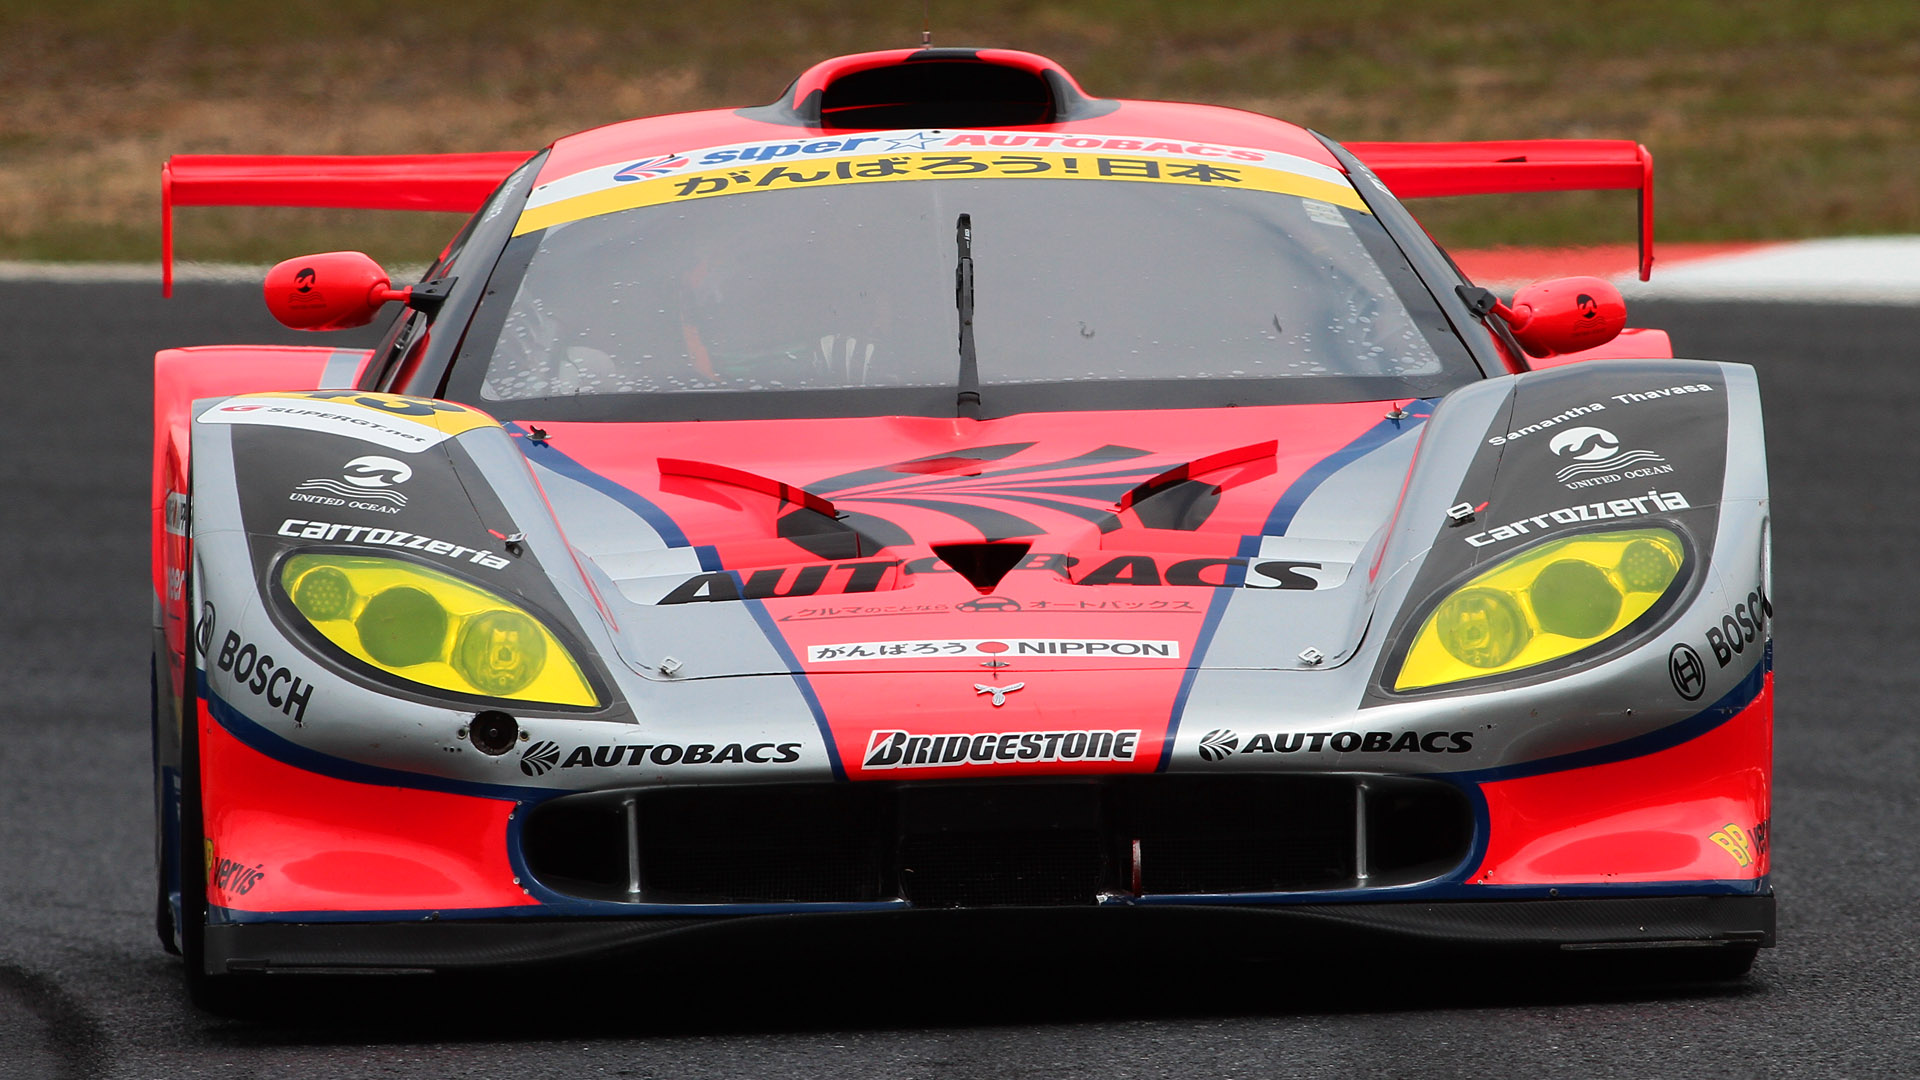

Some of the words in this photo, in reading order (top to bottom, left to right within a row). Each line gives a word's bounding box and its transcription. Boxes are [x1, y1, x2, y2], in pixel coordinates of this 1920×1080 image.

[698, 136, 881, 166] super
[943, 134, 1267, 162] AUTOBACS
[266, 407, 427, 443] SUPERGT.net
[1487, 400, 1606, 447] Samantha
[1611, 382, 1714, 405] Thavasa
[1565, 473, 1622, 491] UNITED
[1624, 464, 1674, 480] OCEAN
[288, 492, 345, 507] UNITED
[348, 500, 403, 515] OCEAN
[1463, 489, 1691, 549] carrozzeria
[277, 518, 511, 571] carrozzeria
[1029, 600, 1195, 610] オートバックス
[815, 641, 968, 660] がんばろう
[1018, 641, 1170, 657] NIPPON
[217, 629, 314, 723] BOSCH
[560, 743, 802, 769] AUTOBACS
[863, 731, 1136, 767] BRIDGESTONE
[1240, 731, 1474, 754] AUTOBACS
